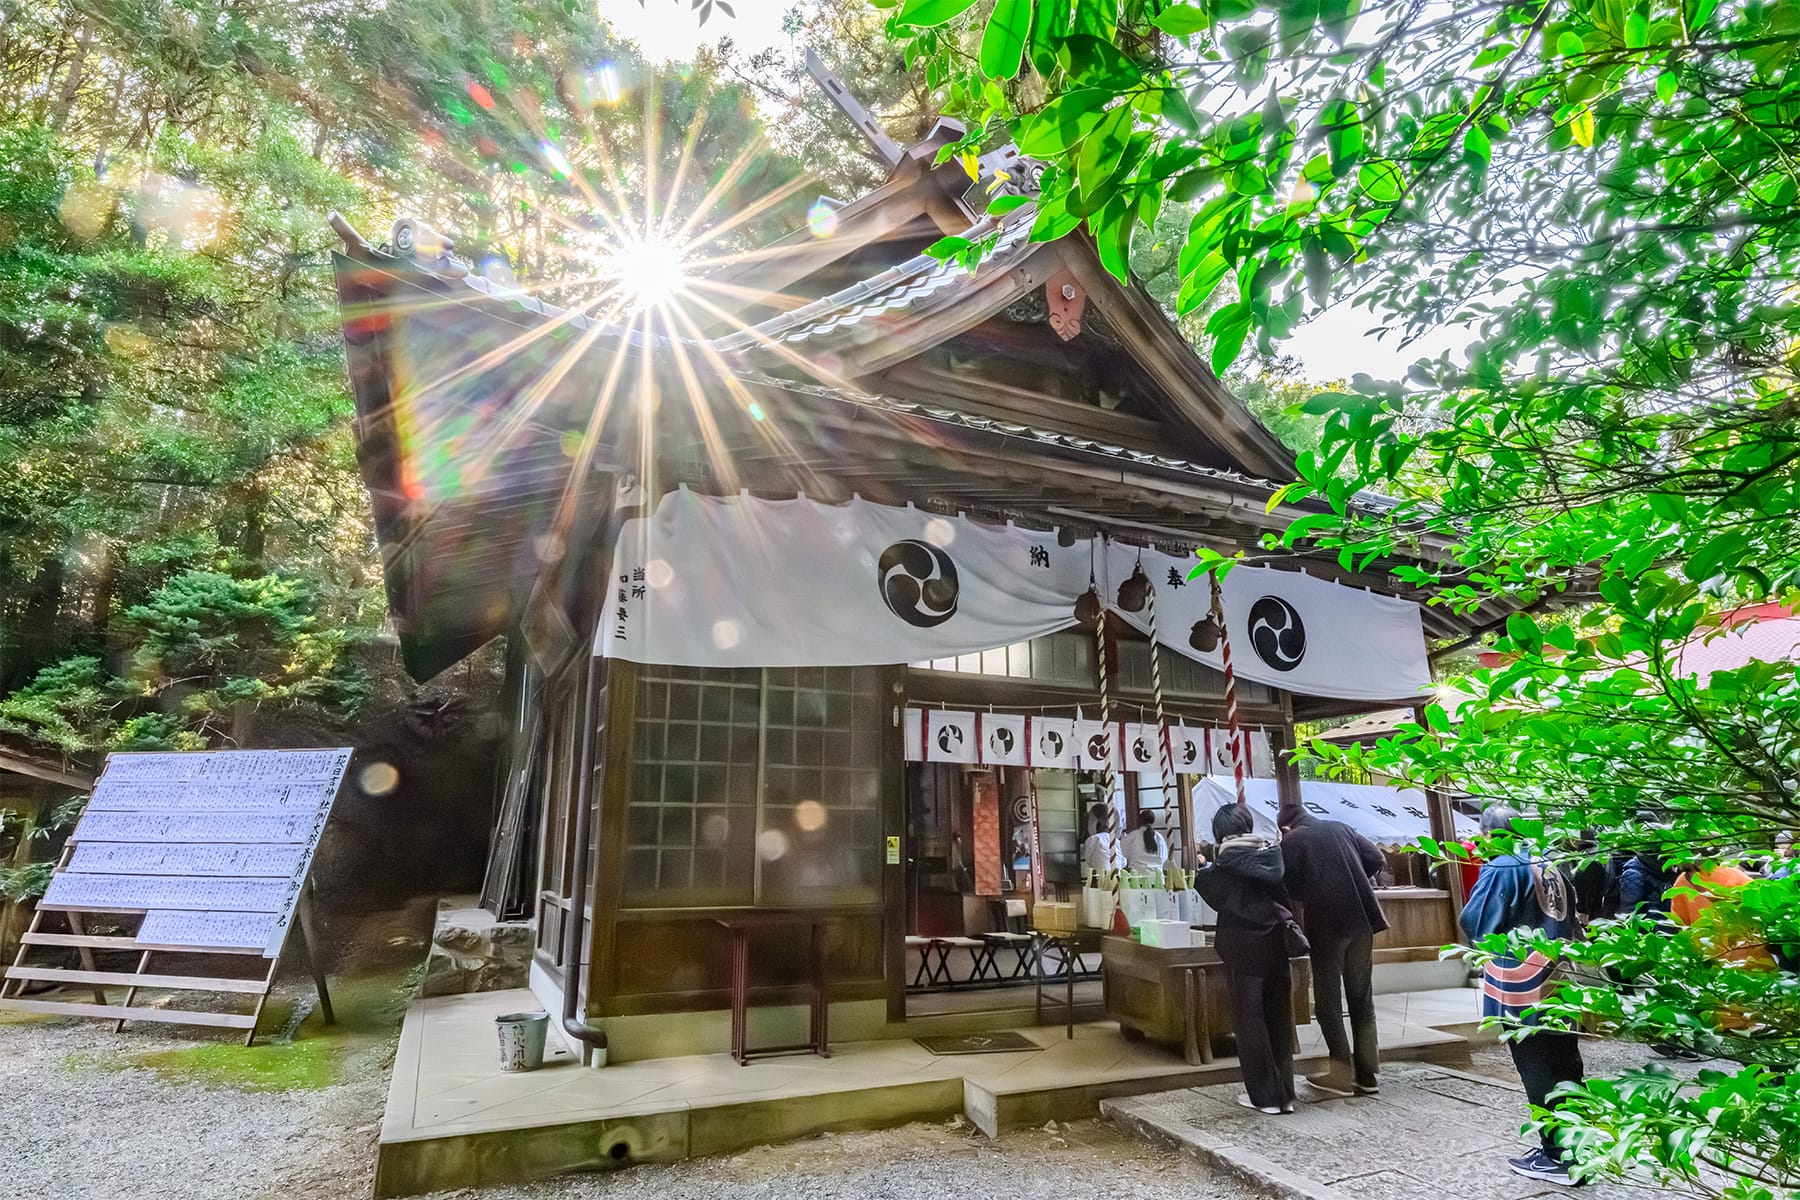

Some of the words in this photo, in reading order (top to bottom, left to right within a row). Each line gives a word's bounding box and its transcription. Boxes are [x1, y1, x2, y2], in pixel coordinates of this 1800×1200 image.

[1030, 545, 1050, 569] 納
[632, 567, 647, 601] 当所
[1166, 565, 1187, 590] 奉
